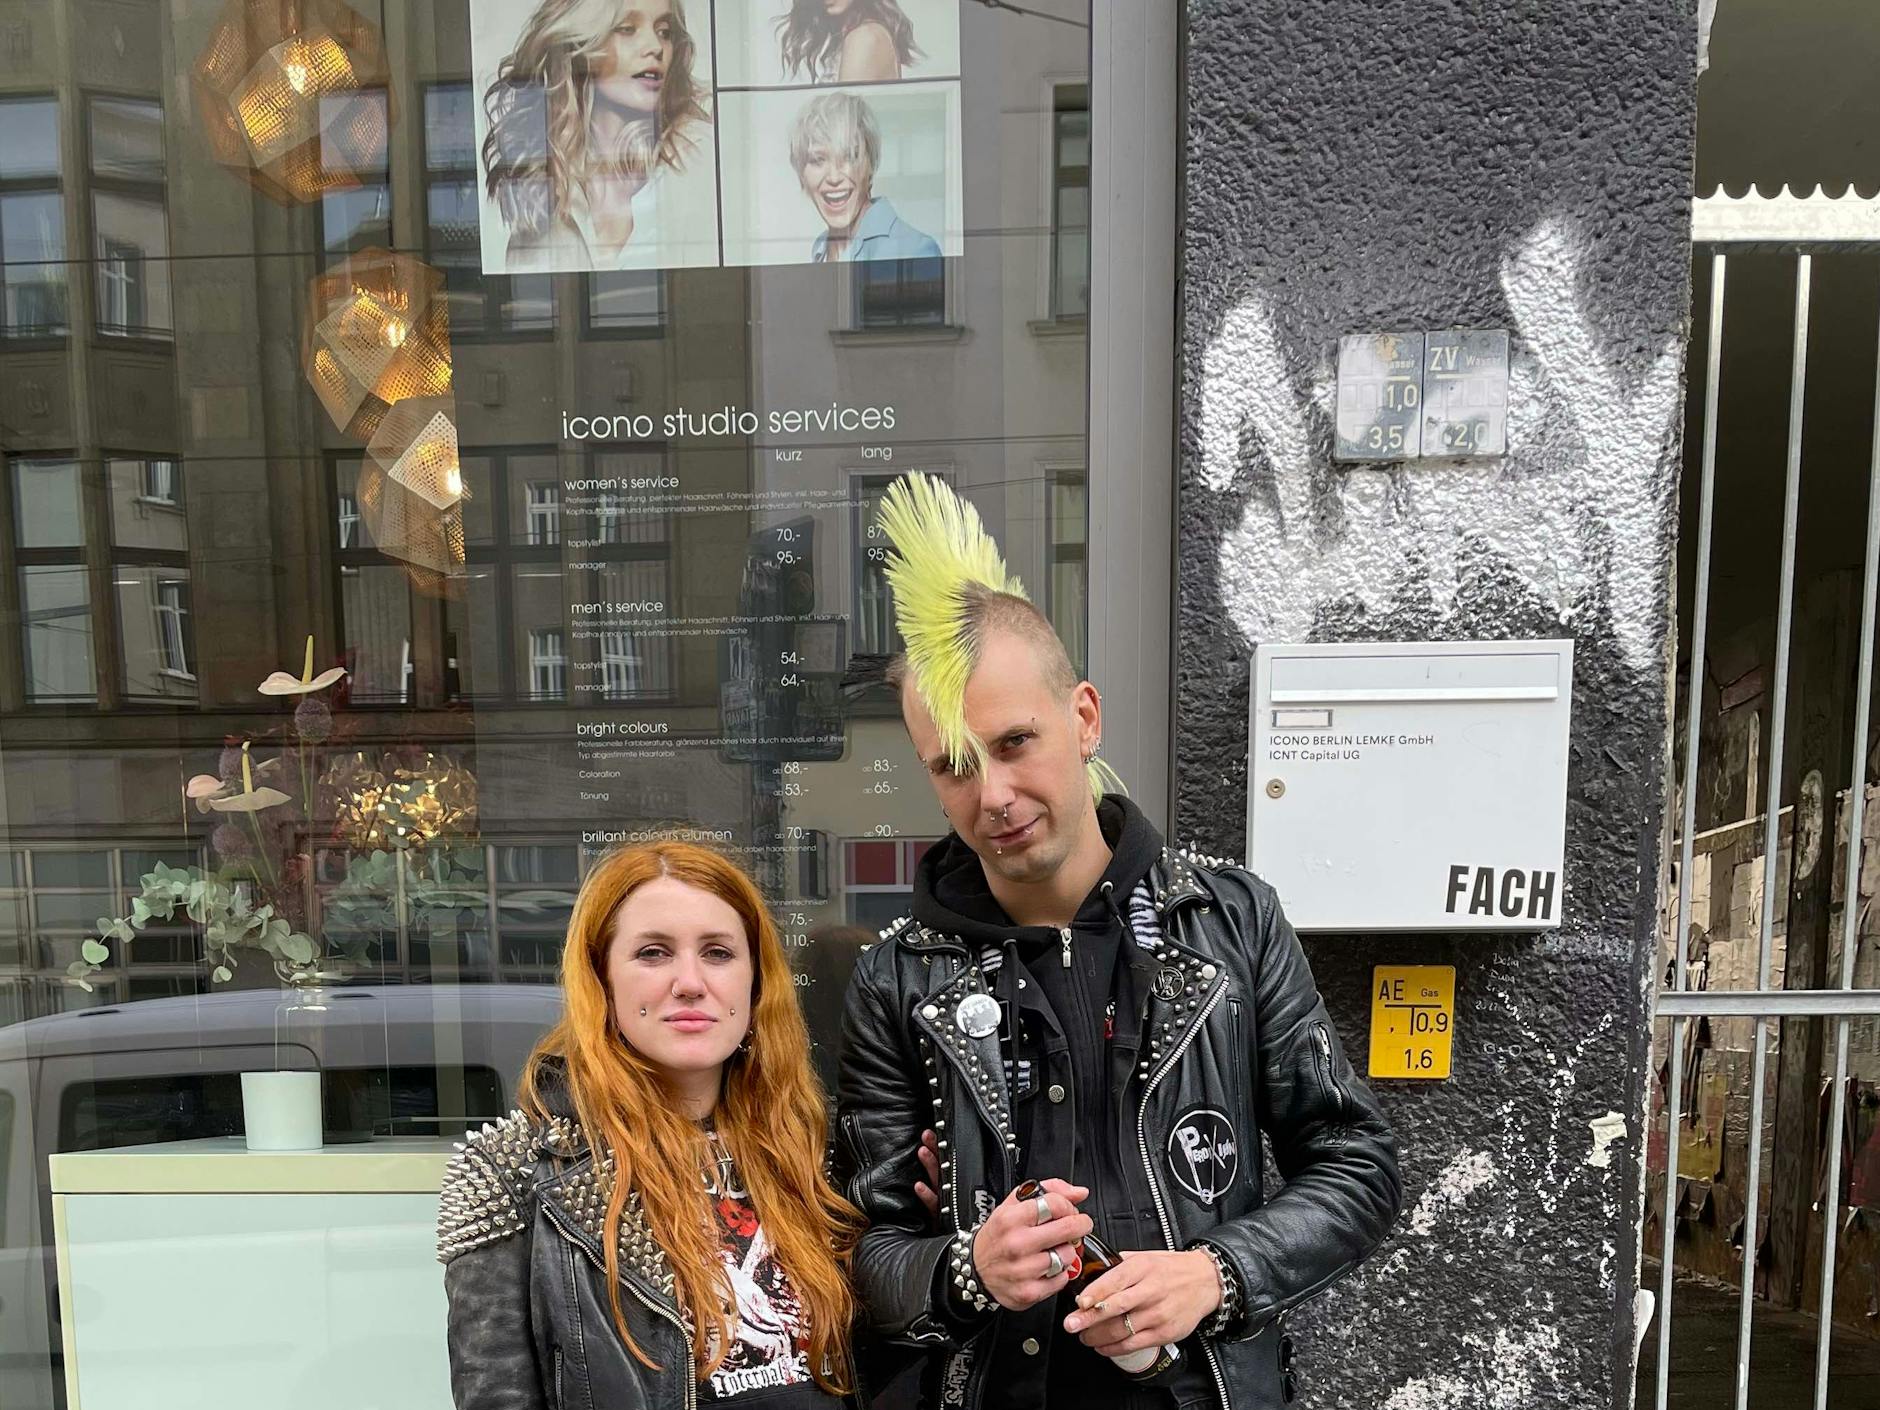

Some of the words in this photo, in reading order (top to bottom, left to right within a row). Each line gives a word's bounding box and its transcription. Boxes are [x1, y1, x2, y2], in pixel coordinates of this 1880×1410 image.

[1429, 346, 1459, 371] ZV
[1387, 384, 1418, 411] 1,0
[562, 410, 654, 440] icono
[663, 406, 758, 438] studio
[768, 402, 896, 433] services
[1369, 425, 1403, 453] 3,5
[776, 449, 802, 462] kurz
[861, 446, 893, 461] lang
[630, 474, 680, 489] service
[776, 528, 801, 543] 70,-
[776, 550, 802, 565] 95,-
[569, 561, 607, 571] manager
[615, 600, 664, 614] service
[780, 651, 806, 665] 54,-
[780, 673, 806, 687] 64,-
[577, 721, 616, 738] bright
[619, 721, 669, 734] colours
[1269, 735, 1310, 746] ICONO
[1312, 735, 1353, 746] BERLIN
[1356, 735, 1395, 745] LEMKE
[1398, 734, 1434, 745] GmbH
[578, 751, 591, 761] Typ
[1269, 750, 1298, 761] ICNT
[1300, 750, 1340, 762] Capital
[1343, 750, 1360, 760] UG
[783, 760, 808, 775] 68,-
[873, 759, 899, 773] 83,-
[579, 769, 621, 779] Coloration
[784, 783, 810, 797] 53,-
[874, 780, 899, 795] 65,-
[580, 790, 610, 802] Tönung
[582, 830, 627, 843] brillant
[630, 829, 679, 842] colours
[786, 826, 811, 841] 70,-
[874, 824, 900, 838] 90,-
[1445, 864, 1556, 920] FACH
[1378, 979, 1405, 1001] AE
[1420, 987, 1439, 998] Gas
[1416, 1012, 1448, 1034] 0,9
[1404, 1048, 1433, 1071] 1,6
